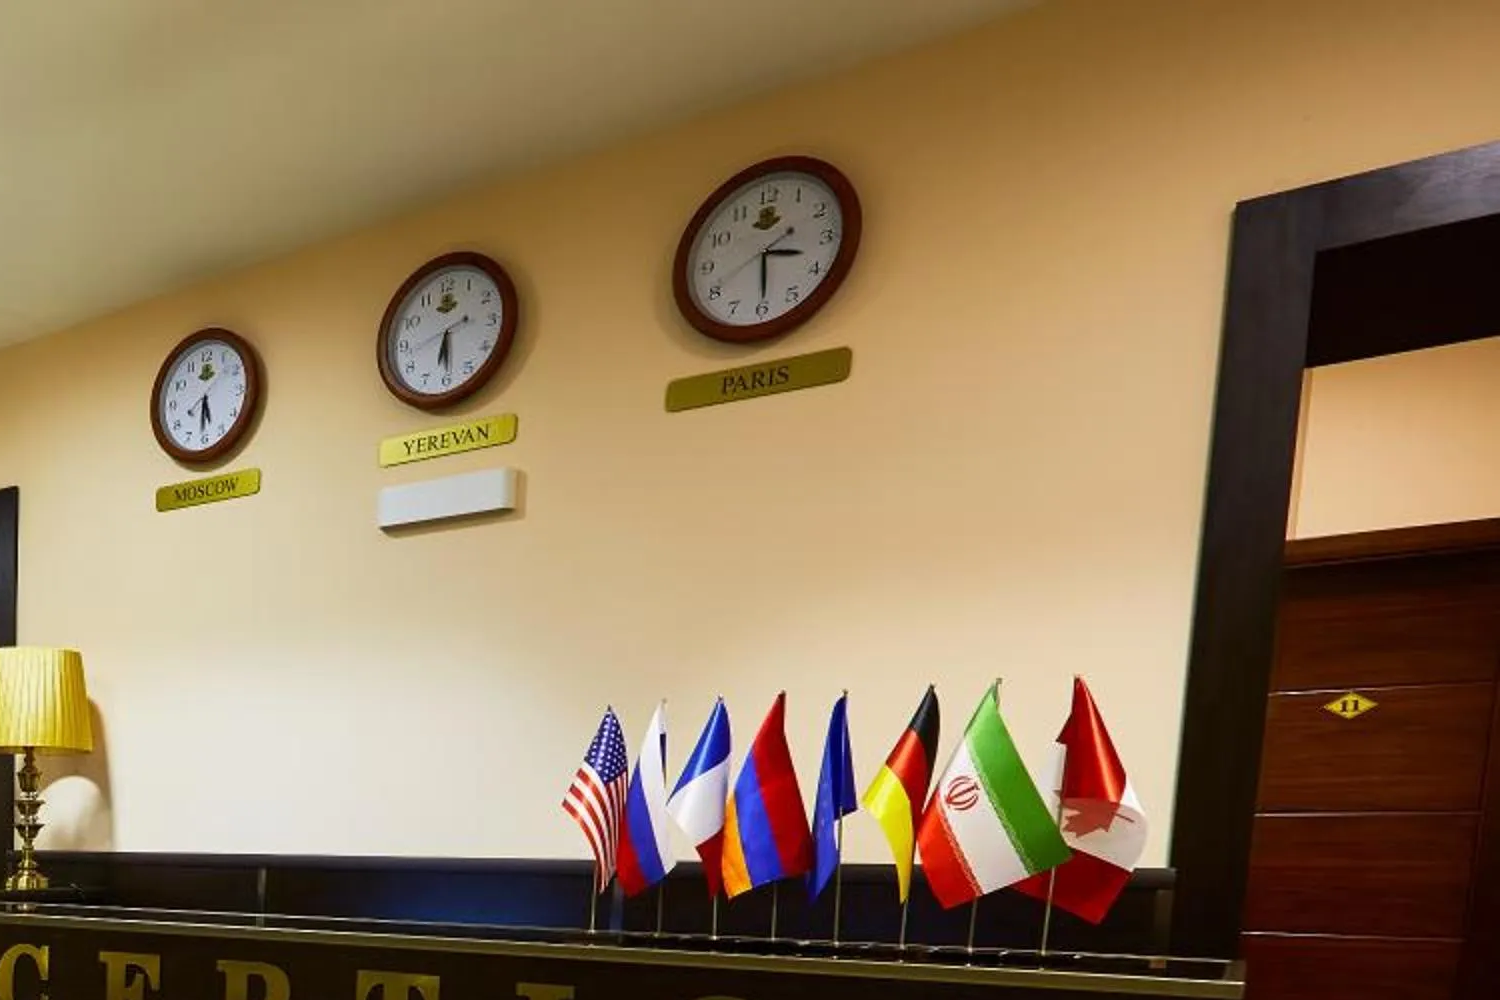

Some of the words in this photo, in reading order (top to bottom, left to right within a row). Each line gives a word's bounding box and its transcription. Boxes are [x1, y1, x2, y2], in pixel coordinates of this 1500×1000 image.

[759, 186, 780, 205] 12
[794, 188, 802, 203] 1
[732, 206, 747, 221] 11
[813, 202, 828, 219] 2
[710, 231, 731, 249] 10
[820, 230, 833, 245] 3
[700, 260, 715, 275] 9
[808, 261, 821, 276] 4
[440, 278, 456, 293] 12
[466, 279, 471, 291] 1
[421, 293, 431, 308] 11
[481, 290, 492, 305] 2
[708, 287, 722, 301] 8
[785, 287, 799, 303] 5
[727, 301, 740, 318] 7
[755, 301, 769, 320] 6
[404, 316, 421, 330] 10
[486, 313, 498, 327] 3
[399, 340, 409, 354] 9
[480, 340, 490, 352] 4
[405, 360, 416, 374] 8
[462, 360, 474, 374] 5
[421, 373, 431, 387] 7
[441, 372, 452, 387] 6
[721, 365, 790, 396] PARIS
[404, 423, 490, 456] YEREVAN
[173, 477, 239, 502] MOSCOW
[1340, 700, 1359, 712] 11
